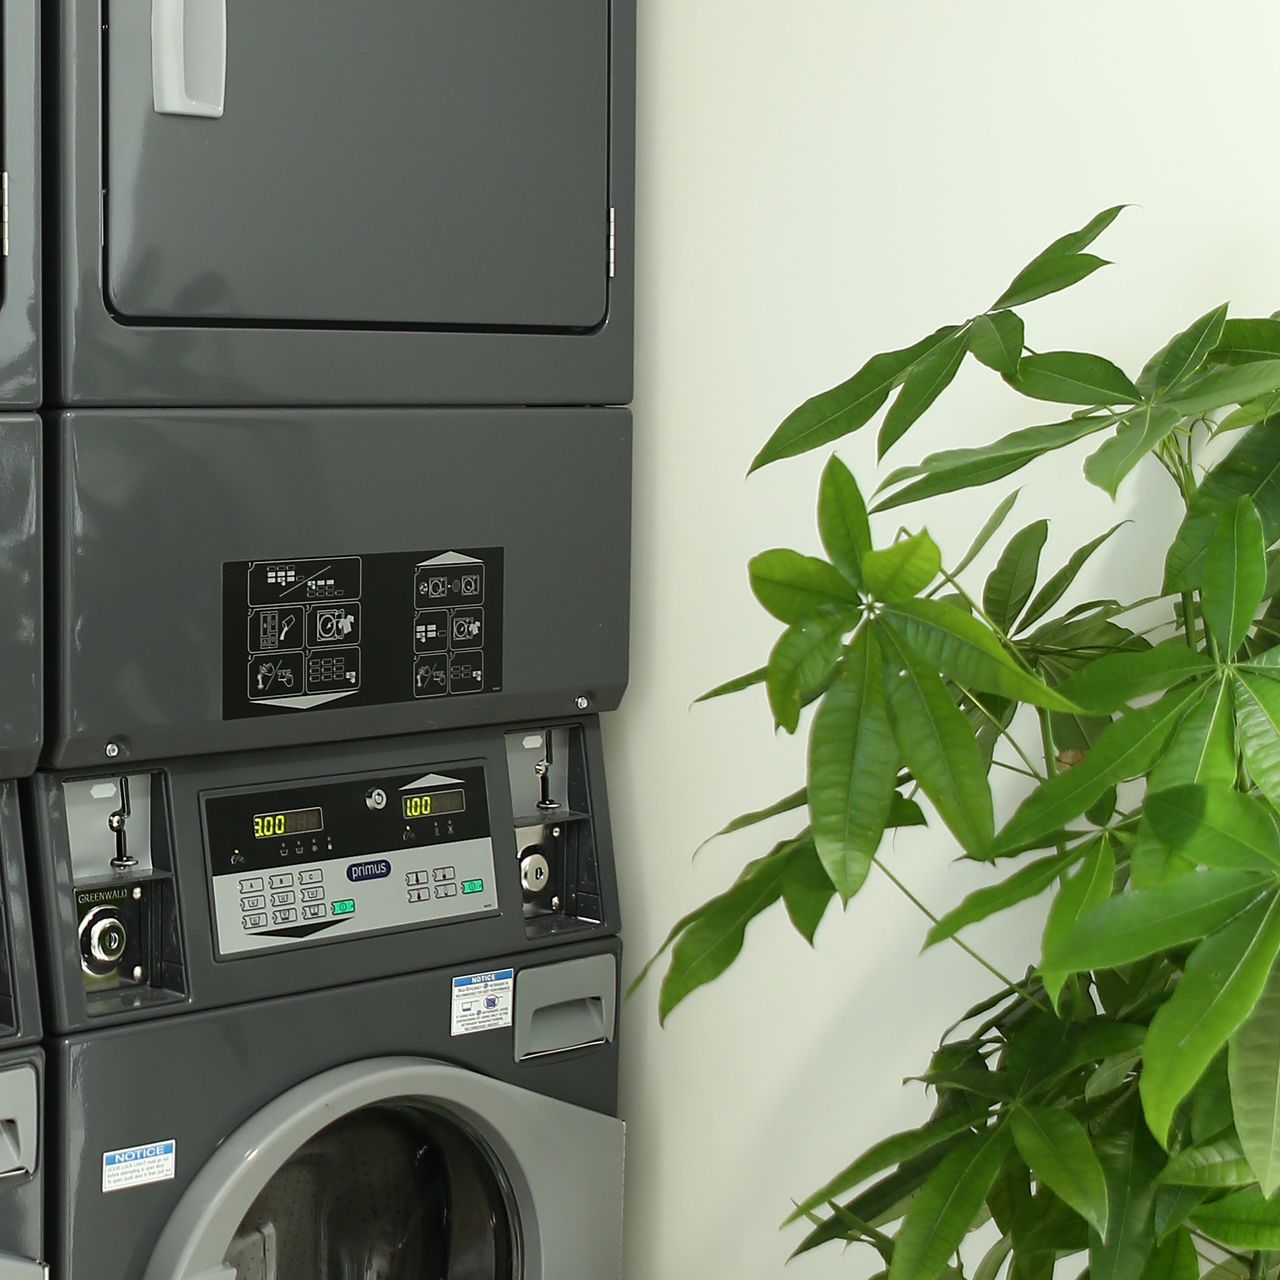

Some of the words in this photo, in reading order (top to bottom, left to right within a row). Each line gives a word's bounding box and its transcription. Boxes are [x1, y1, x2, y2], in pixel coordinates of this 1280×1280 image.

[406, 796, 431, 816] 1.00
[351, 861, 387, 880] primus
[78, 888, 128, 904] GREENWALD
[471, 973, 496, 983] NOTICE
[115, 1145, 165, 1163] NOTICE
